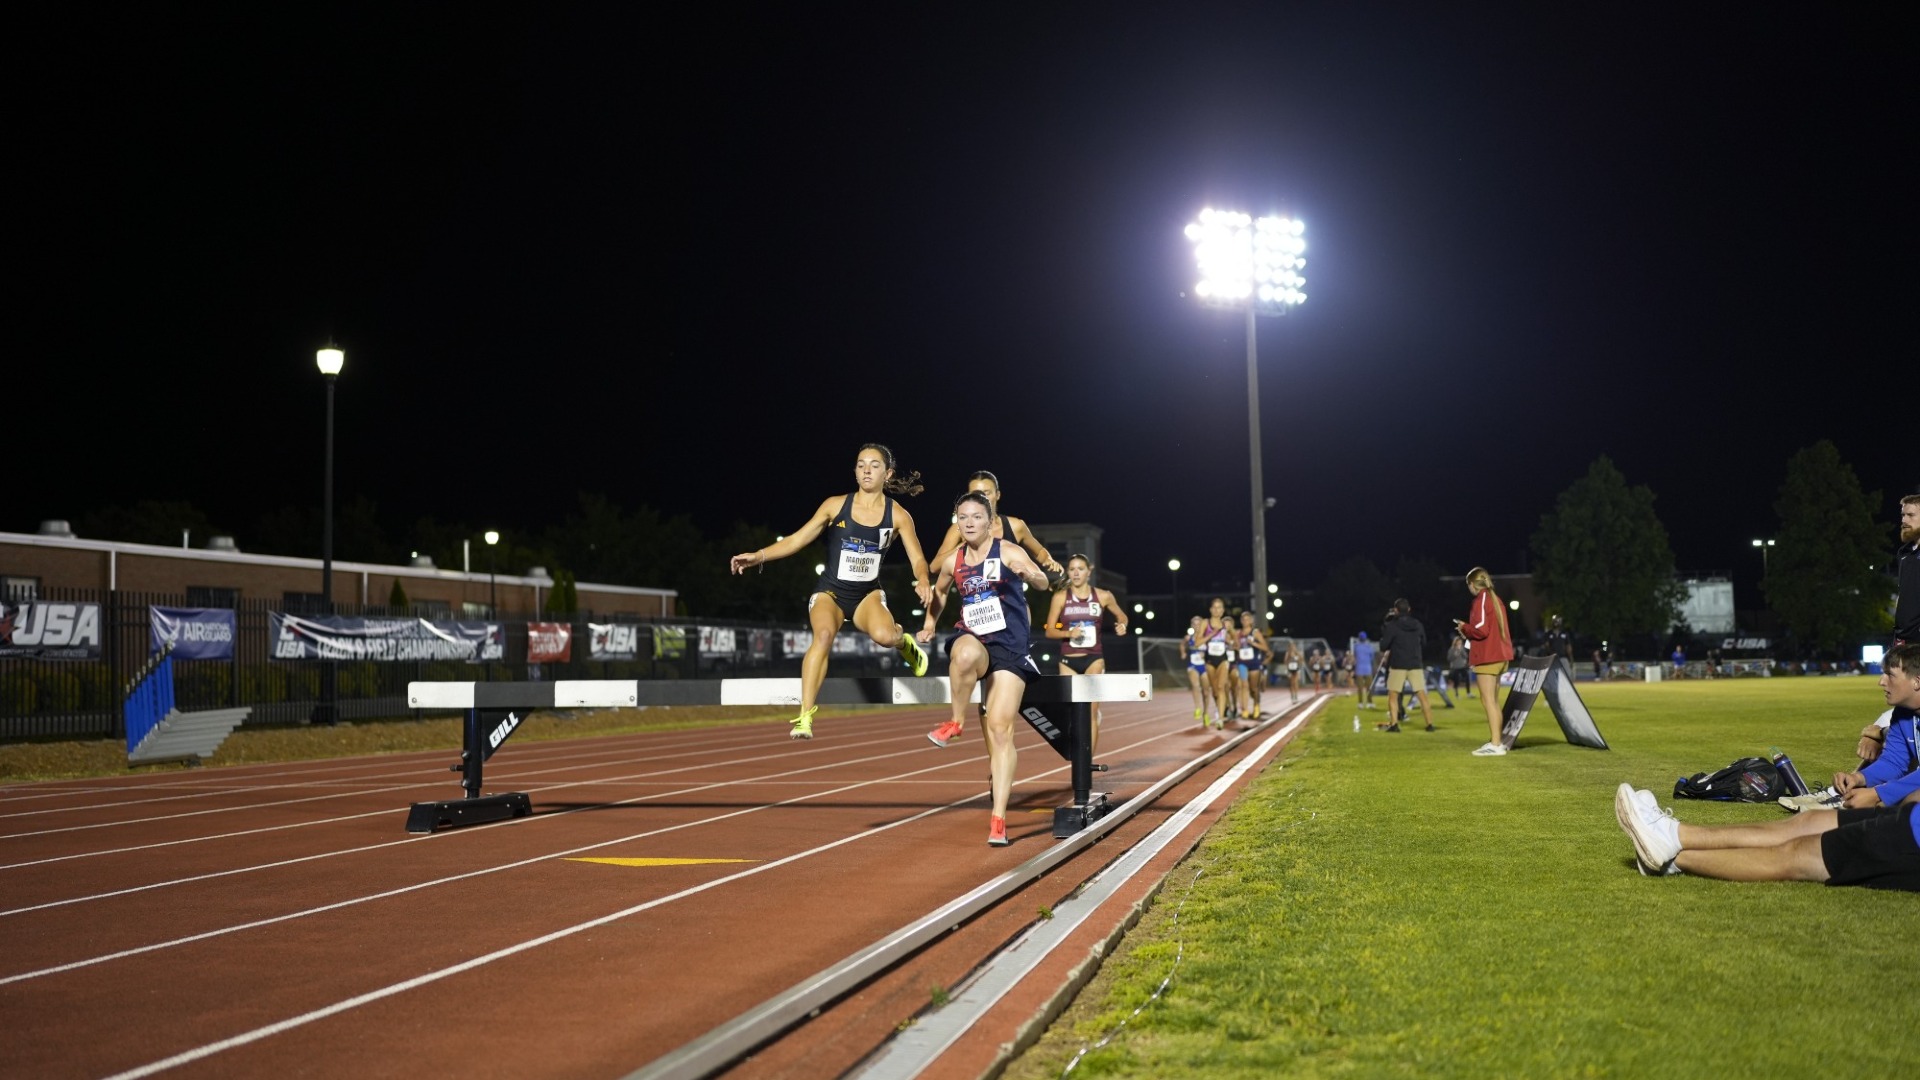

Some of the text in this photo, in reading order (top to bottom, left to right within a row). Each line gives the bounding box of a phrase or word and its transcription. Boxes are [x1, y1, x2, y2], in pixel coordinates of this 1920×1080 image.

[883, 529, 890, 546] 1
[845, 556, 875, 565] MADISON
[986, 560, 996, 579] 2
[1092, 603, 1098, 615] 5
[12, 603, 98, 646] USA
[183, 621, 205, 641] AIR
[203, 629, 232, 642] GUARD
[275, 640, 305, 659] USA
[366, 638, 396, 661] FIELD
[489, 711, 519, 748] GILL
[1022, 707, 1061, 740] GILL
